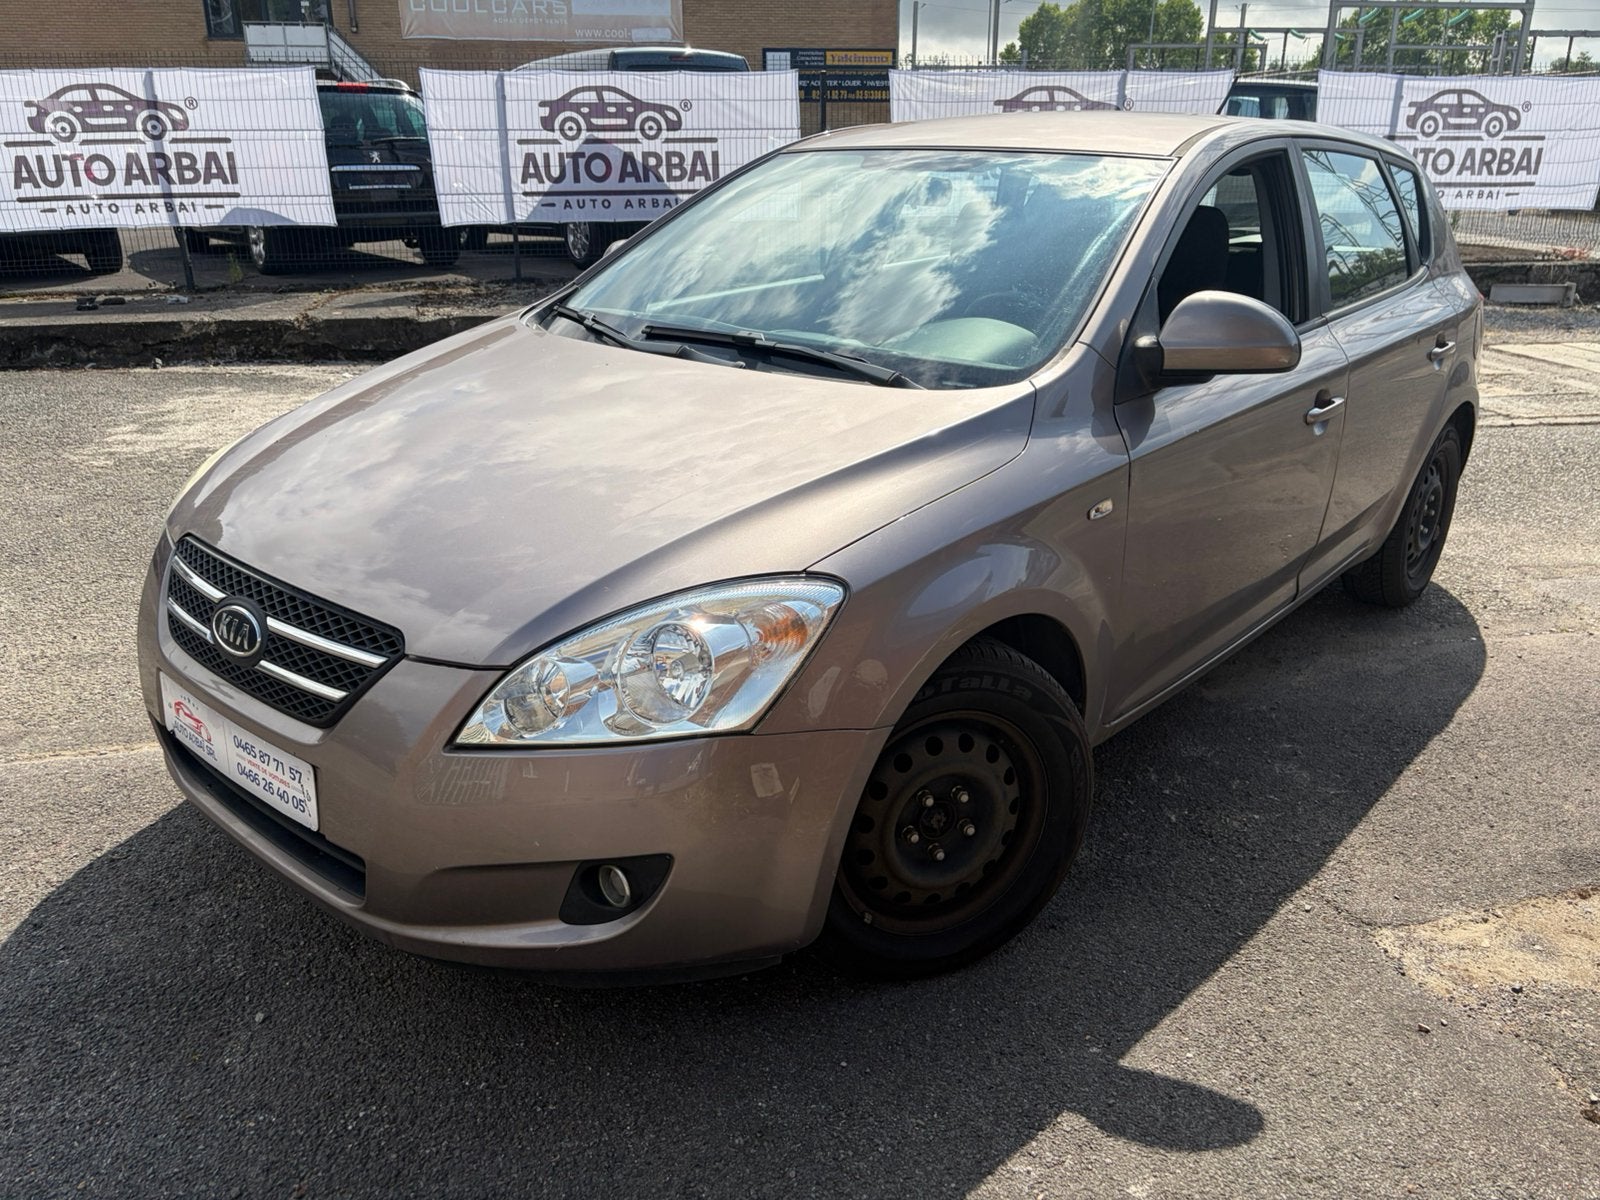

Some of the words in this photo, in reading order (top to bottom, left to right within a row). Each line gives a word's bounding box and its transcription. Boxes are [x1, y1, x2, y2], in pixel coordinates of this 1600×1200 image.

[13, 152, 116, 190] AUTO
[123, 151, 239, 187] ARBAI
[520, 151, 613, 185] AUTO
[618, 150, 720, 184] ARBAI
[1412, 147, 1456, 176] TO
[1456, 147, 1544, 176] ARBAI
[65, 202, 120, 216] AUTO
[134, 201, 197, 215] ARBAI
[563, 198, 612, 210] AUTO
[624, 197, 679, 210] ARBAI
[1455, 189, 1500, 200] ARBAI
[233, 735, 257, 759] 0465
[258, 749, 271, 767] 87
[272, 757, 285, 776] 71
[288, 766, 303, 784] 57
[237, 762, 261, 787] 0466
[262, 777, 275, 796] 26
[276, 786, 289, 805] 40
[291, 795, 306, 813] 05
